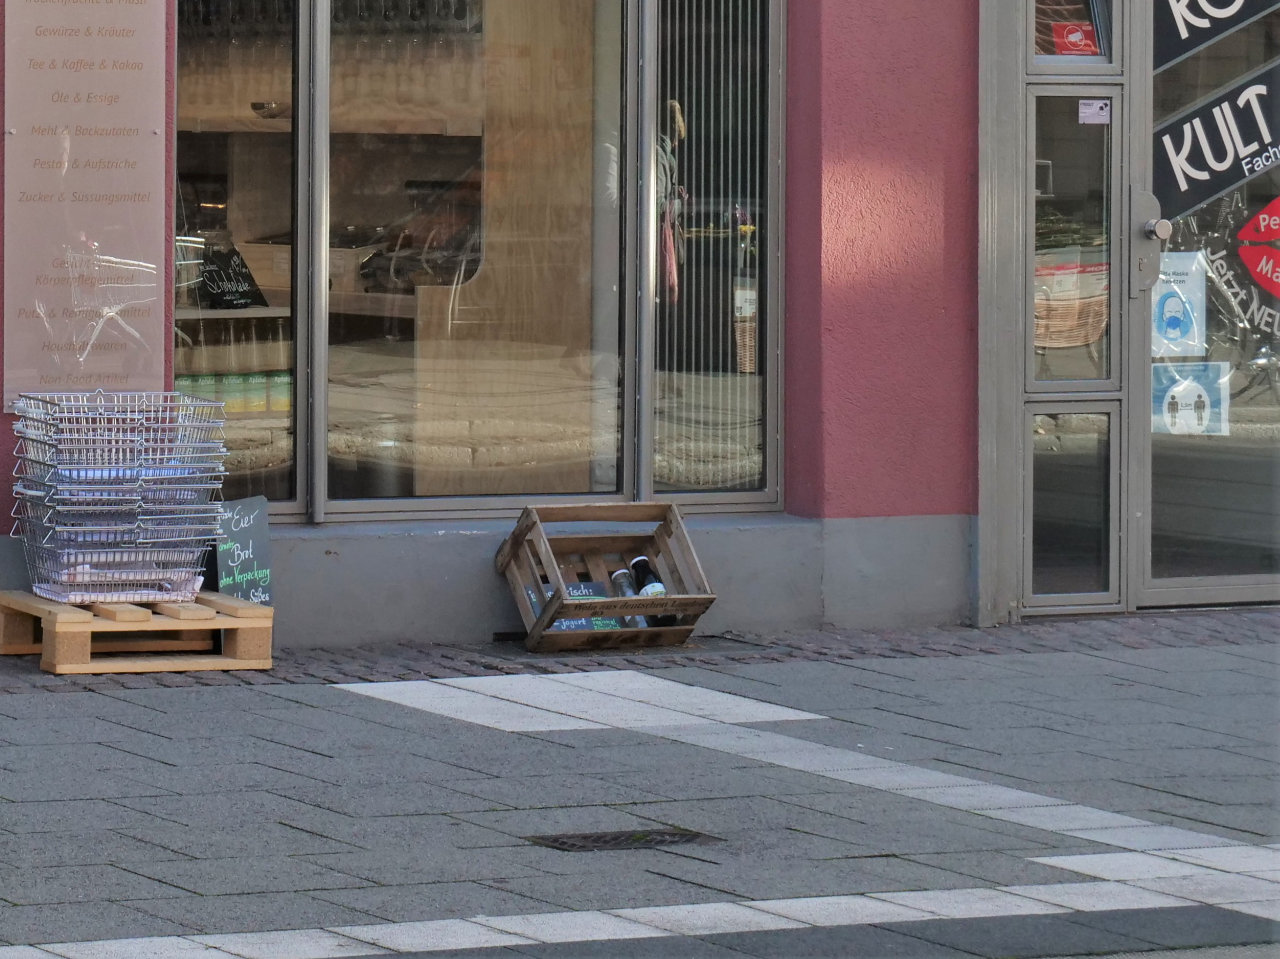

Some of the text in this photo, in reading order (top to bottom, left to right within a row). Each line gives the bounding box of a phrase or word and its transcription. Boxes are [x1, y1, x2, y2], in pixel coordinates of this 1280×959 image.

[34, 25, 137, 38] Gewürze & Kräuter
[27, 58, 144, 73] Tee & Kaffee & Kakao
[51, 90, 121, 106] Öle & Essige
[31, 125, 58, 136] Mehl
[74, 125, 140, 137] Backzutaten
[1161, 84, 1273, 192] KULT
[71, 159, 80, 170] &
[83, 158, 138, 172] Aufstriche
[1241, 144, 1280, 177] Fach
[18, 191, 151, 205] Zucker & Süssungsmittel
[1206, 247, 1248, 304] Jetzt
[62, 307, 152, 321] Reinigumittel
[41, 341, 127, 353] Haushaltwaren
[231, 505, 260, 532] Eier
[228, 539, 254, 567] Brot
[219, 560, 271, 590] ohne Verpackung
[567, 584, 594, 596] risch:
